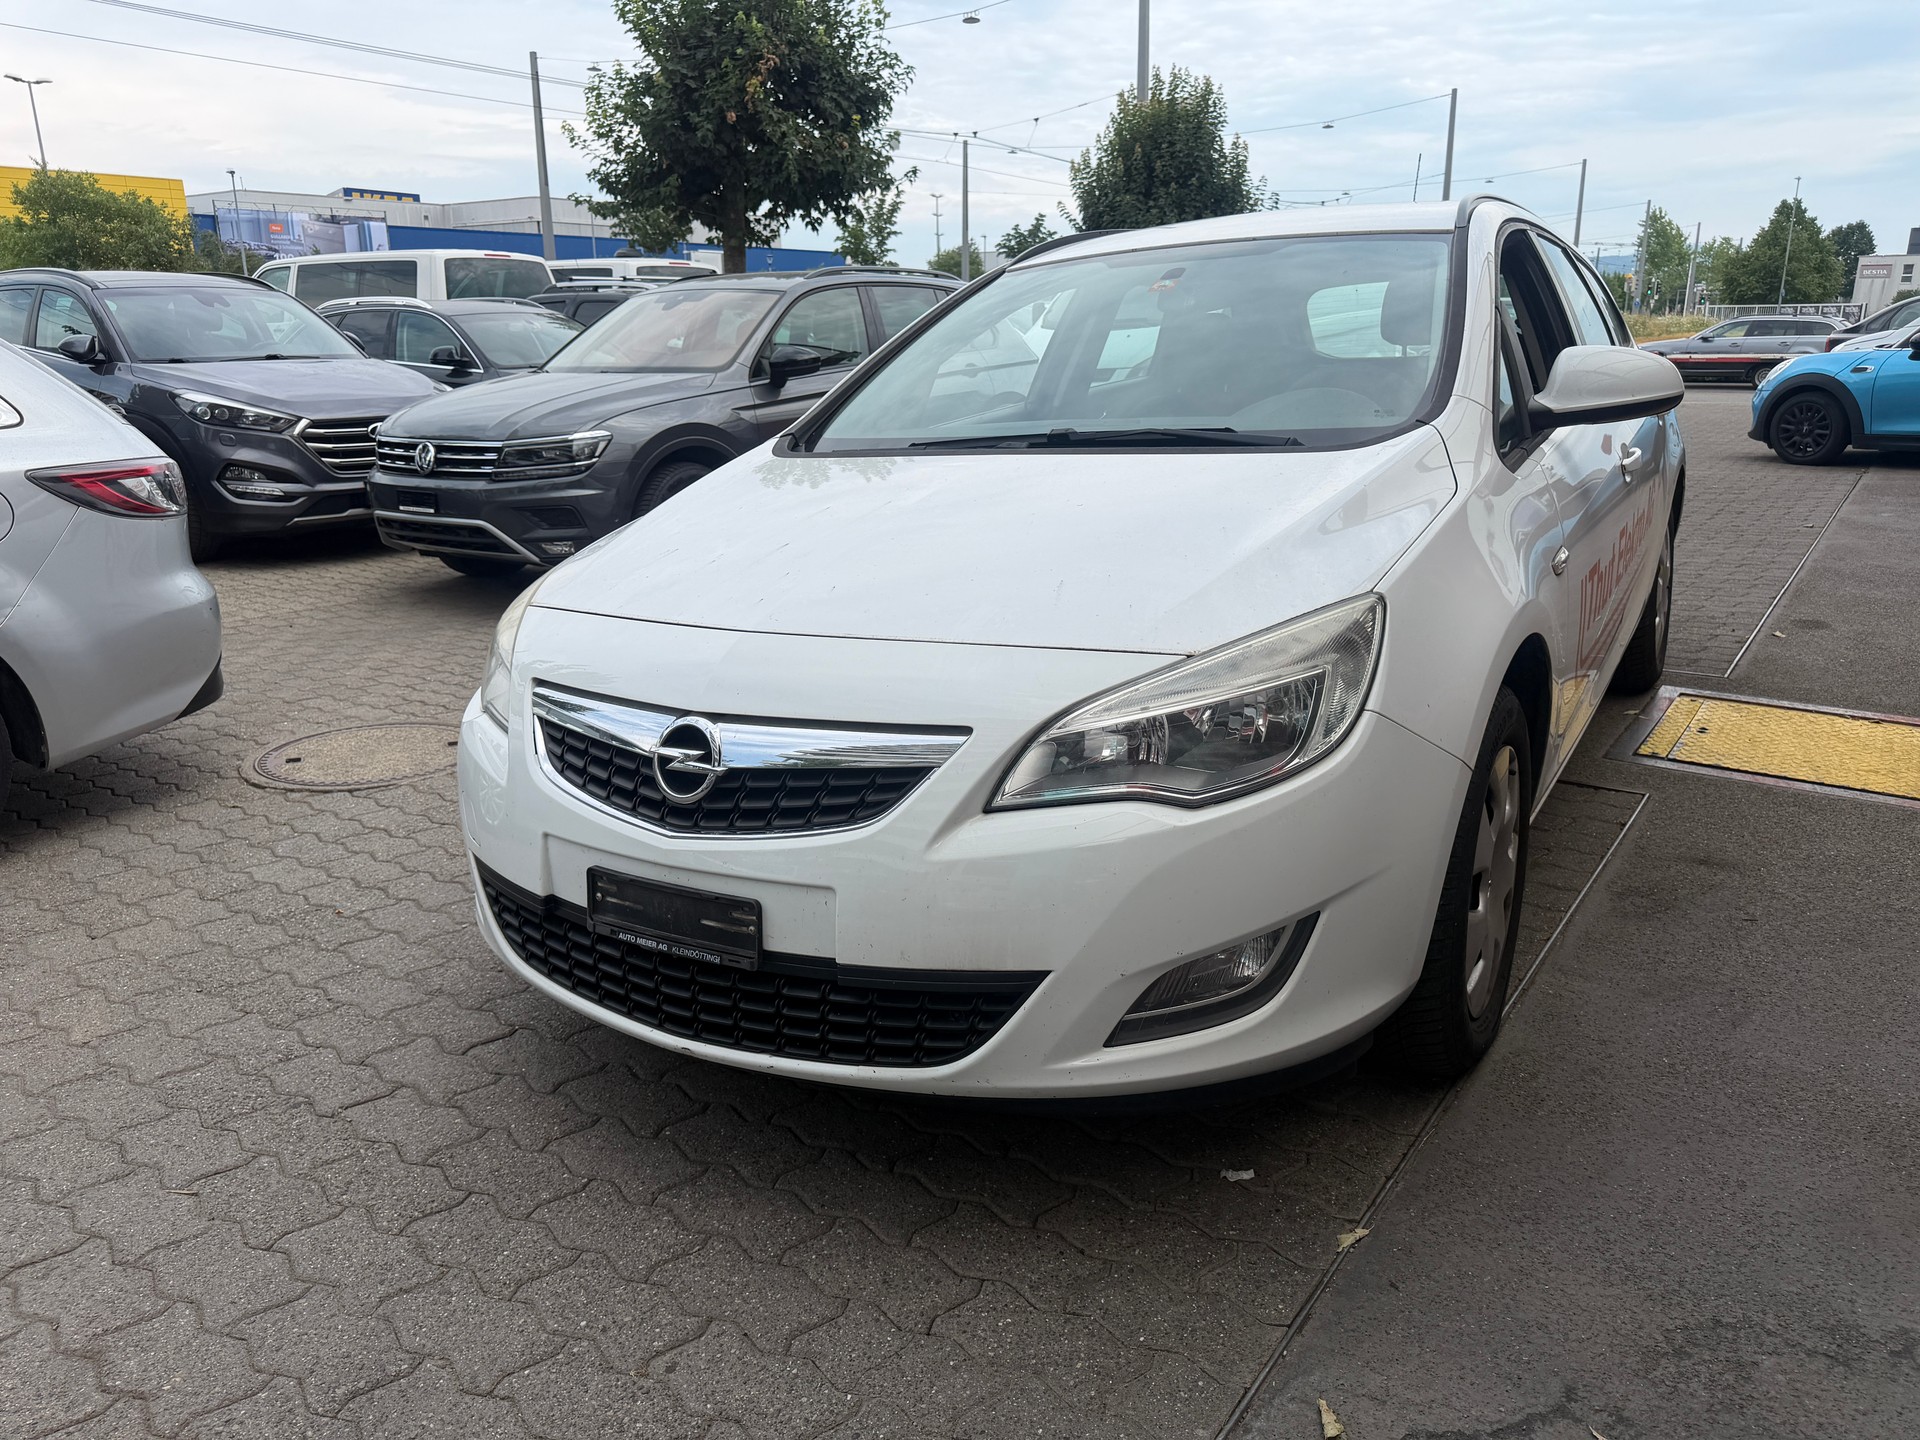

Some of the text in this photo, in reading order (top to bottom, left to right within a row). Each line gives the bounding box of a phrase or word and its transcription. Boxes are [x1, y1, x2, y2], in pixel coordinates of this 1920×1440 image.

[618, 932, 636, 943] AUTO
[636, 937, 657, 949] MEIER
[657, 943, 668, 951] AG
